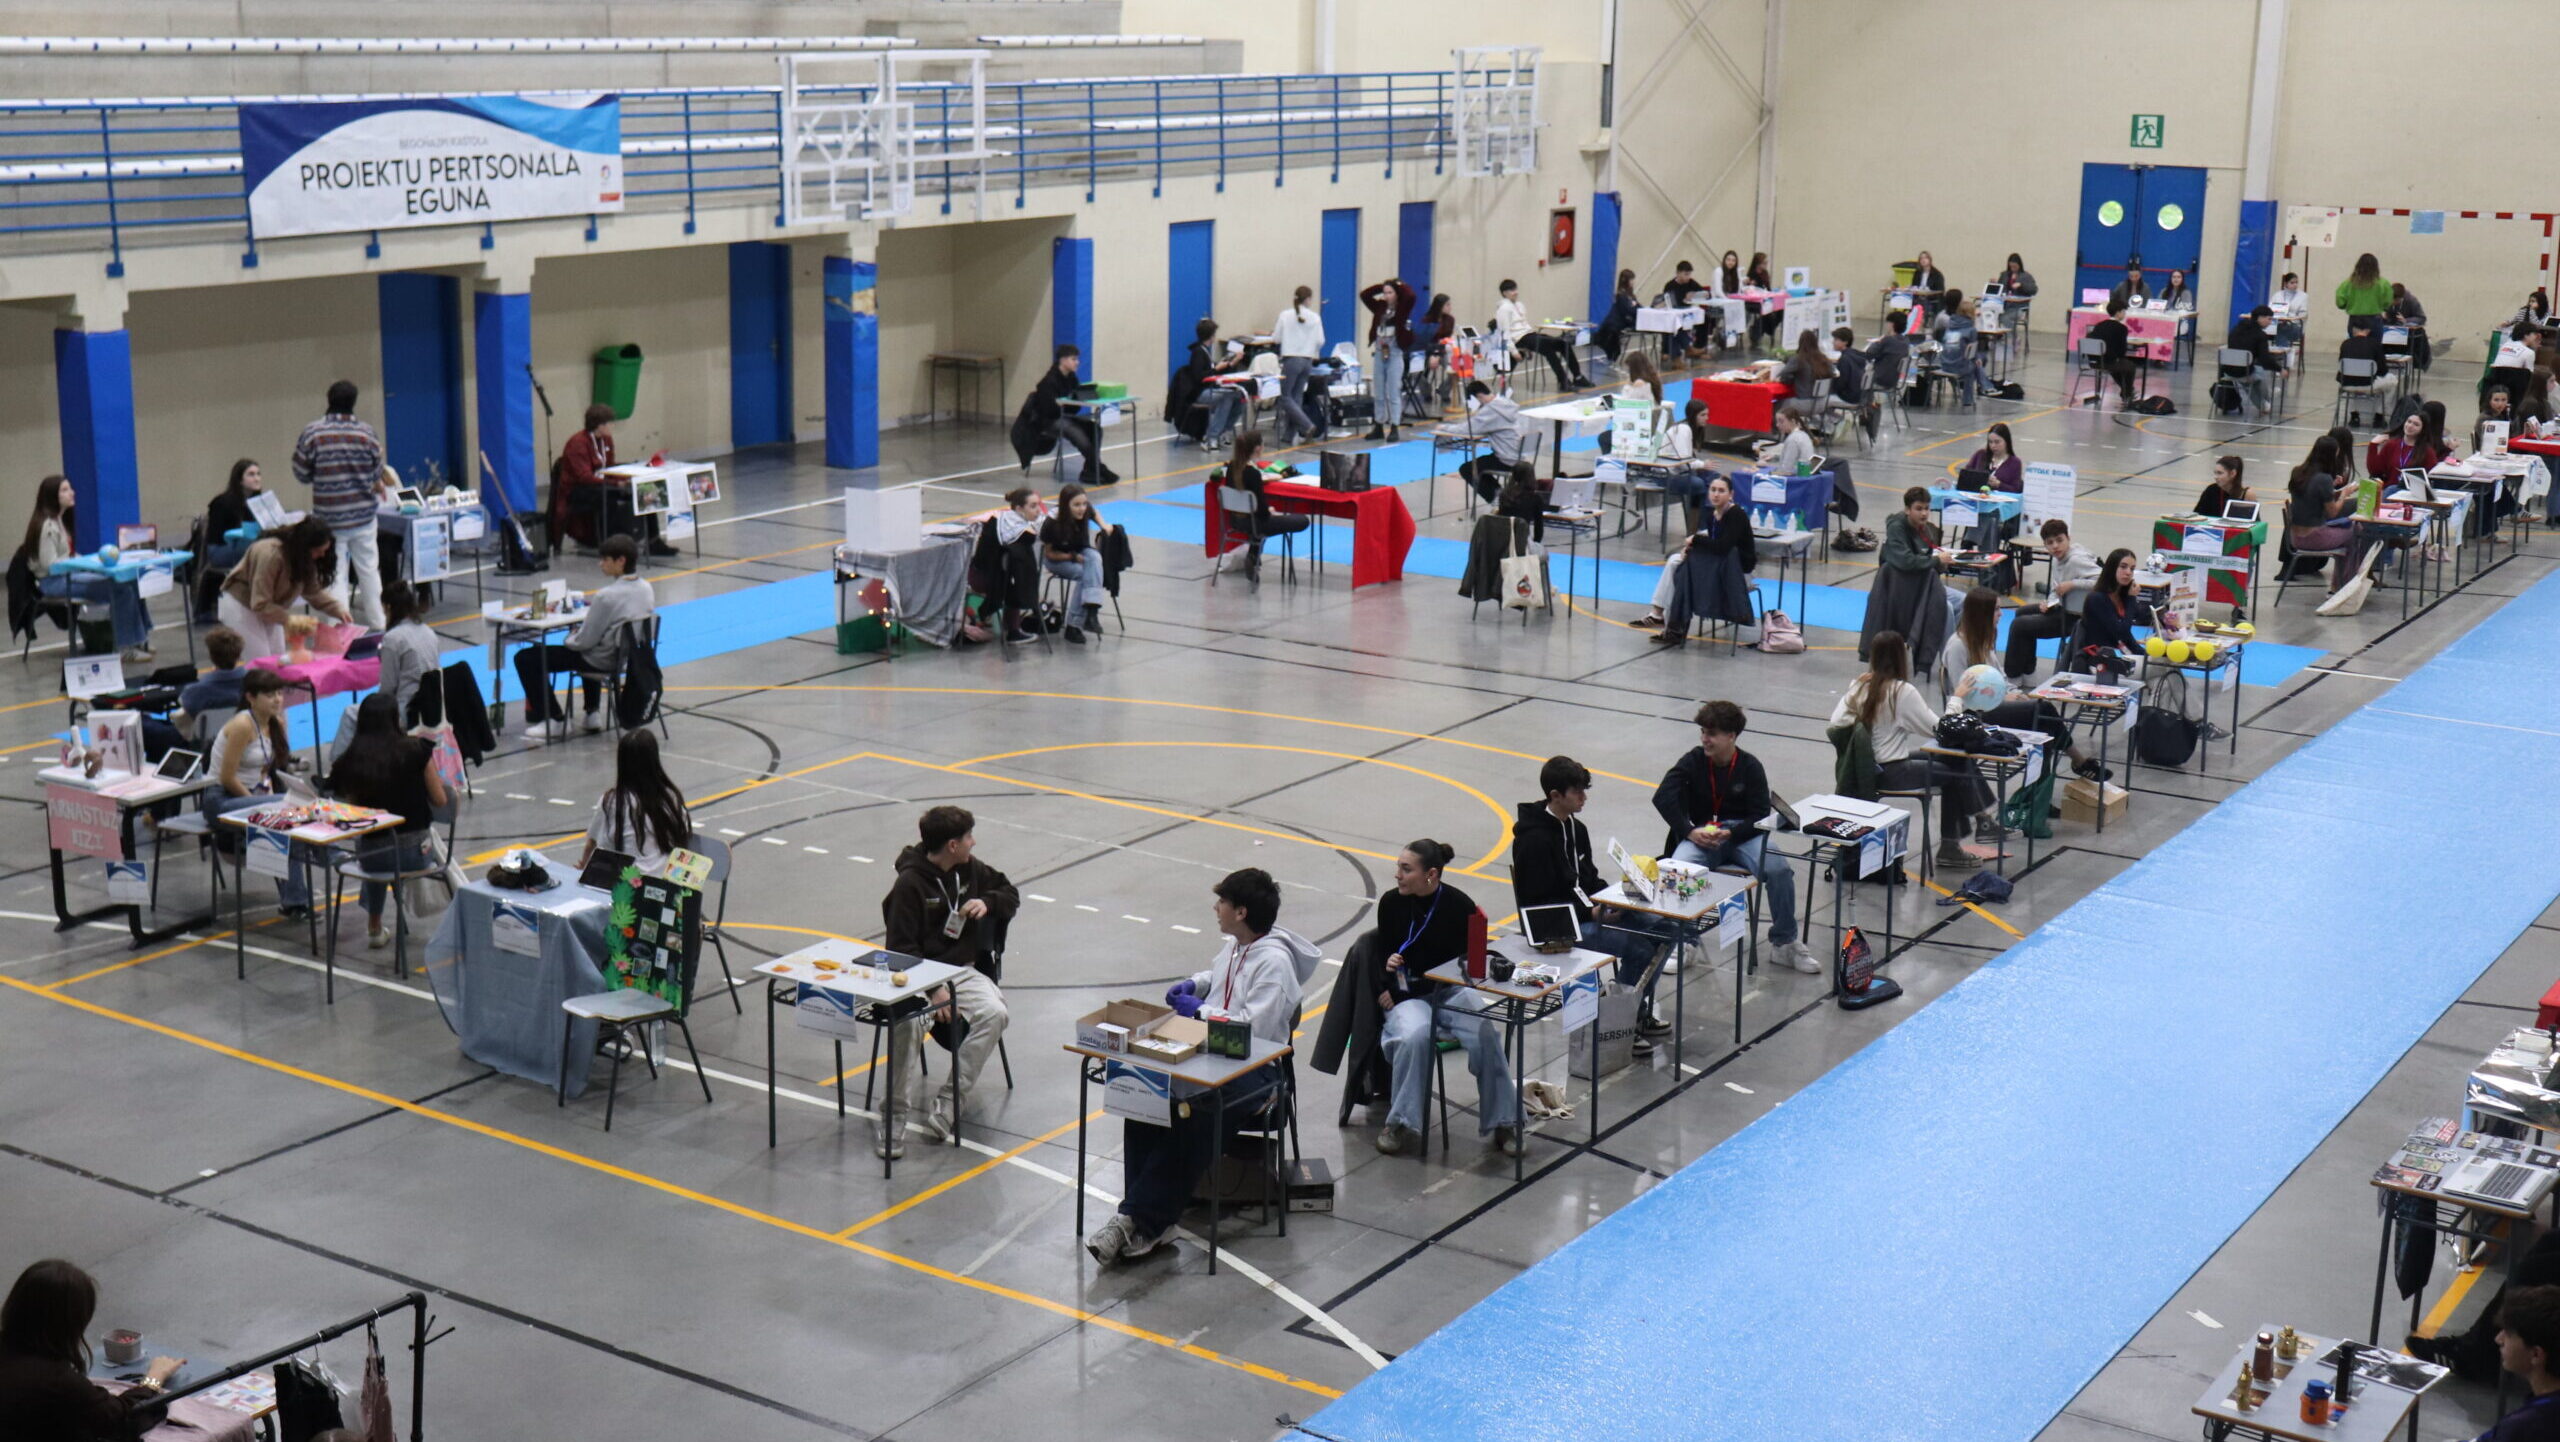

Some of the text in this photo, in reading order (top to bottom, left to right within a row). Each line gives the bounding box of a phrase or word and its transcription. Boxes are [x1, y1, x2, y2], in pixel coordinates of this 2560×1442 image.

[300, 152, 581, 191] PROIEKTU PERTSONALA
[406, 186, 491, 215] EGUNA
